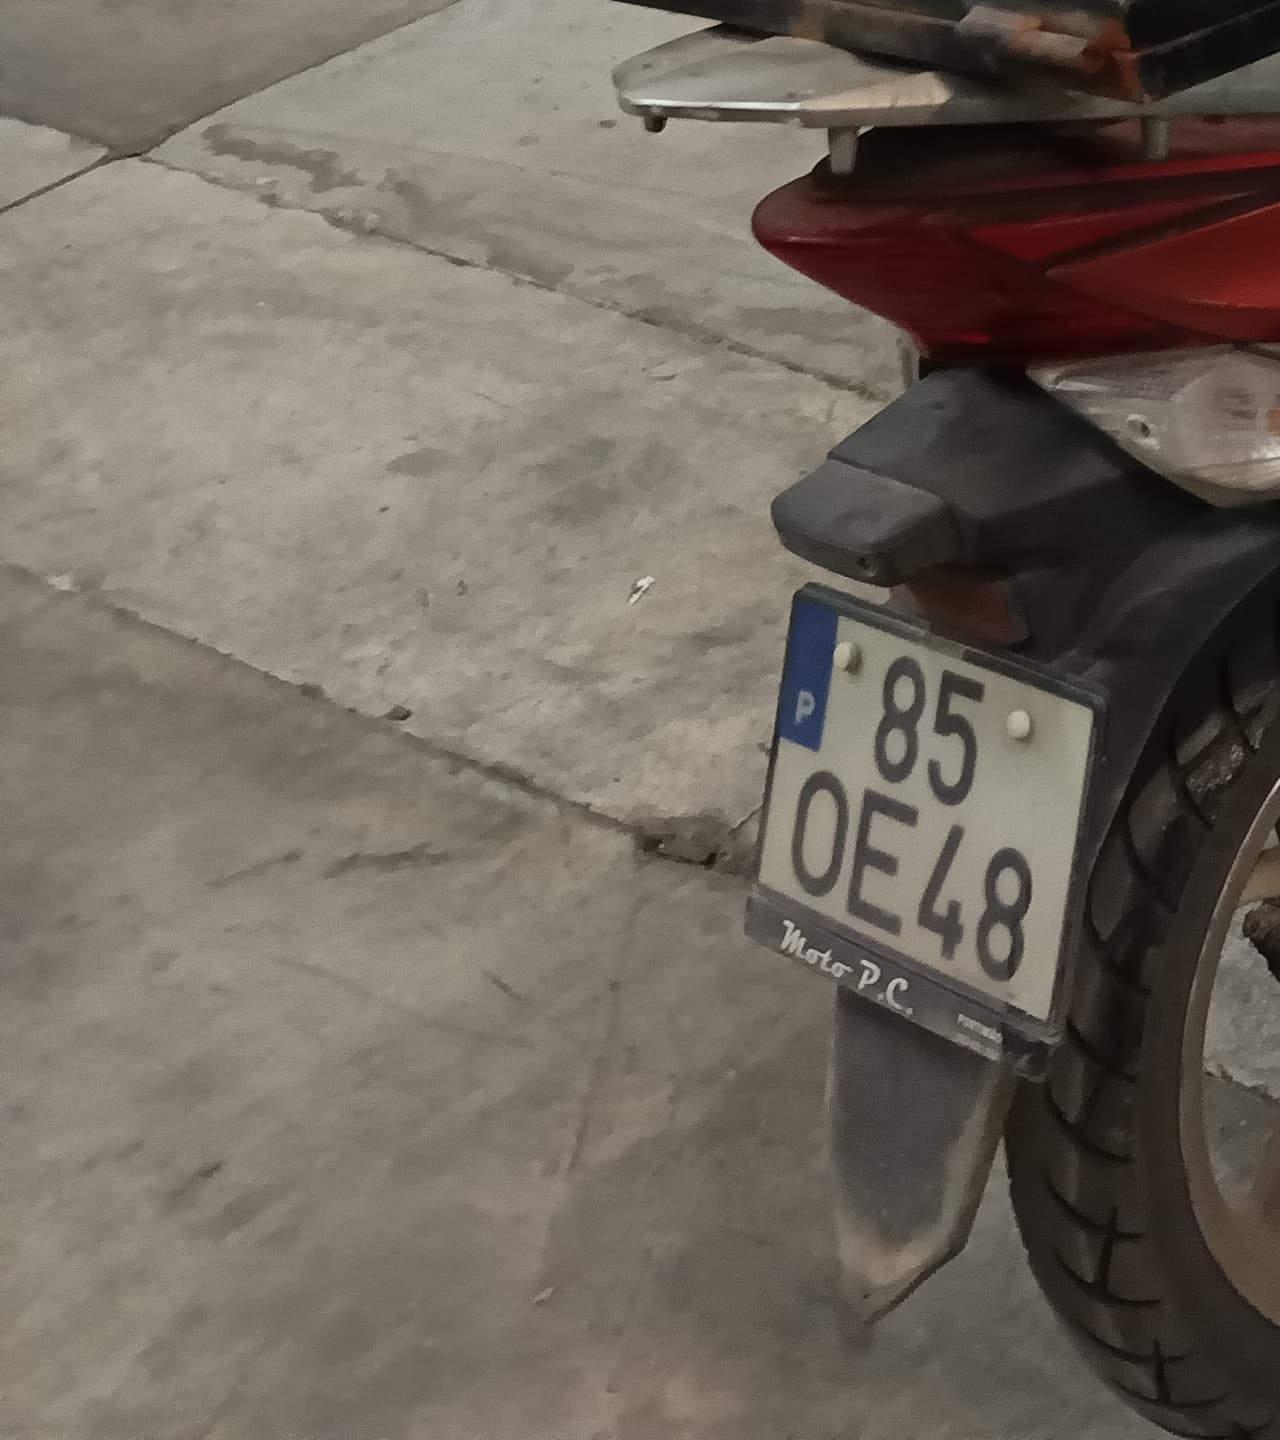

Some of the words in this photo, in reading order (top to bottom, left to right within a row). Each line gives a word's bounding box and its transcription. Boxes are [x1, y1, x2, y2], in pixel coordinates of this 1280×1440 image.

[795, 691, 816, 725] P
[874, 656, 985, 806] 85
[780, 919, 854, 978] Moto
